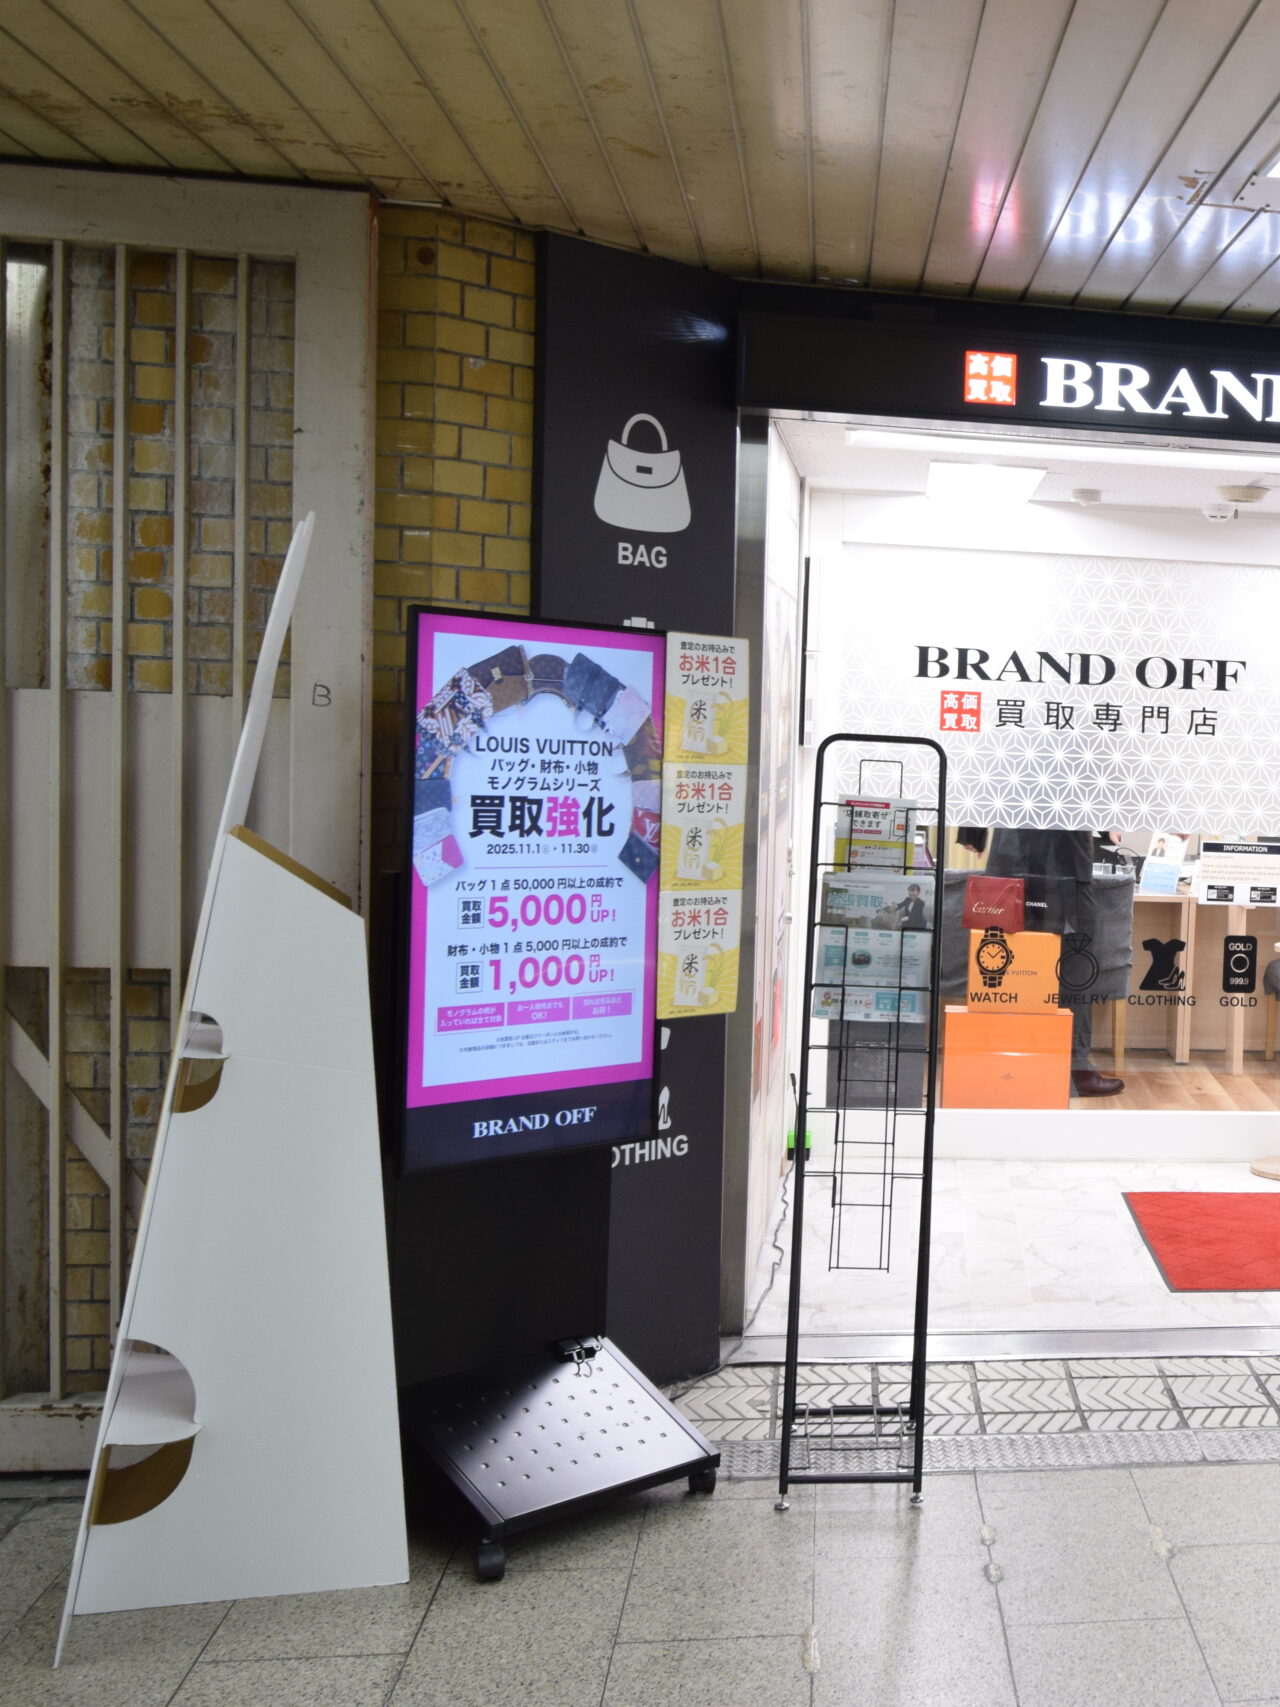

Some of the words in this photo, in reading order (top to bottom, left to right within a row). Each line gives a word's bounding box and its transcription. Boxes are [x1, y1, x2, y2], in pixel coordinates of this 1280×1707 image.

[967, 379, 1013, 404] 買取
[618, 542, 667, 568] BAG
[679, 653, 736, 675] お米1合
[913, 645, 1116, 686] BRAND
[1135, 656, 1247, 692] OFF
[681, 674, 733, 688] プレゼント!
[312, 682, 331, 707] B
[943, 694, 979, 710] 高価
[943, 713, 978, 730] 買取
[995, 699, 1218, 736] 買取専門店
[475, 736, 530, 754] LOUIS
[536, 739, 614, 757] VUITTON
[487, 776, 601, 792] モノグラムシリーズ
[675, 781, 734, 801] お米1合
[469, 795, 615, 838] 買取強化
[677, 802, 729, 814] プレゼント!
[1223, 845, 1268, 853] INFORMATION
[591, 894, 603, 907] 円
[487, 893, 587, 932] 5,000
[671, 907, 729, 928] お米1合
[674, 928, 724, 940] プレゼント!
[1228, 942, 1252, 951] GOLD
[589, 954, 600, 967] 円
[489, 954, 585, 995] 1,000
[970, 992, 1018, 1003] WATCH
[1043, 993, 1109, 1005] JEWELRY
[1127, 994, 1196, 1007] CLOTHING
[1219, 996, 1257, 1007] GOLD
[472, 1113, 550, 1139] BRAND
[555, 1106, 597, 1126] OFF
